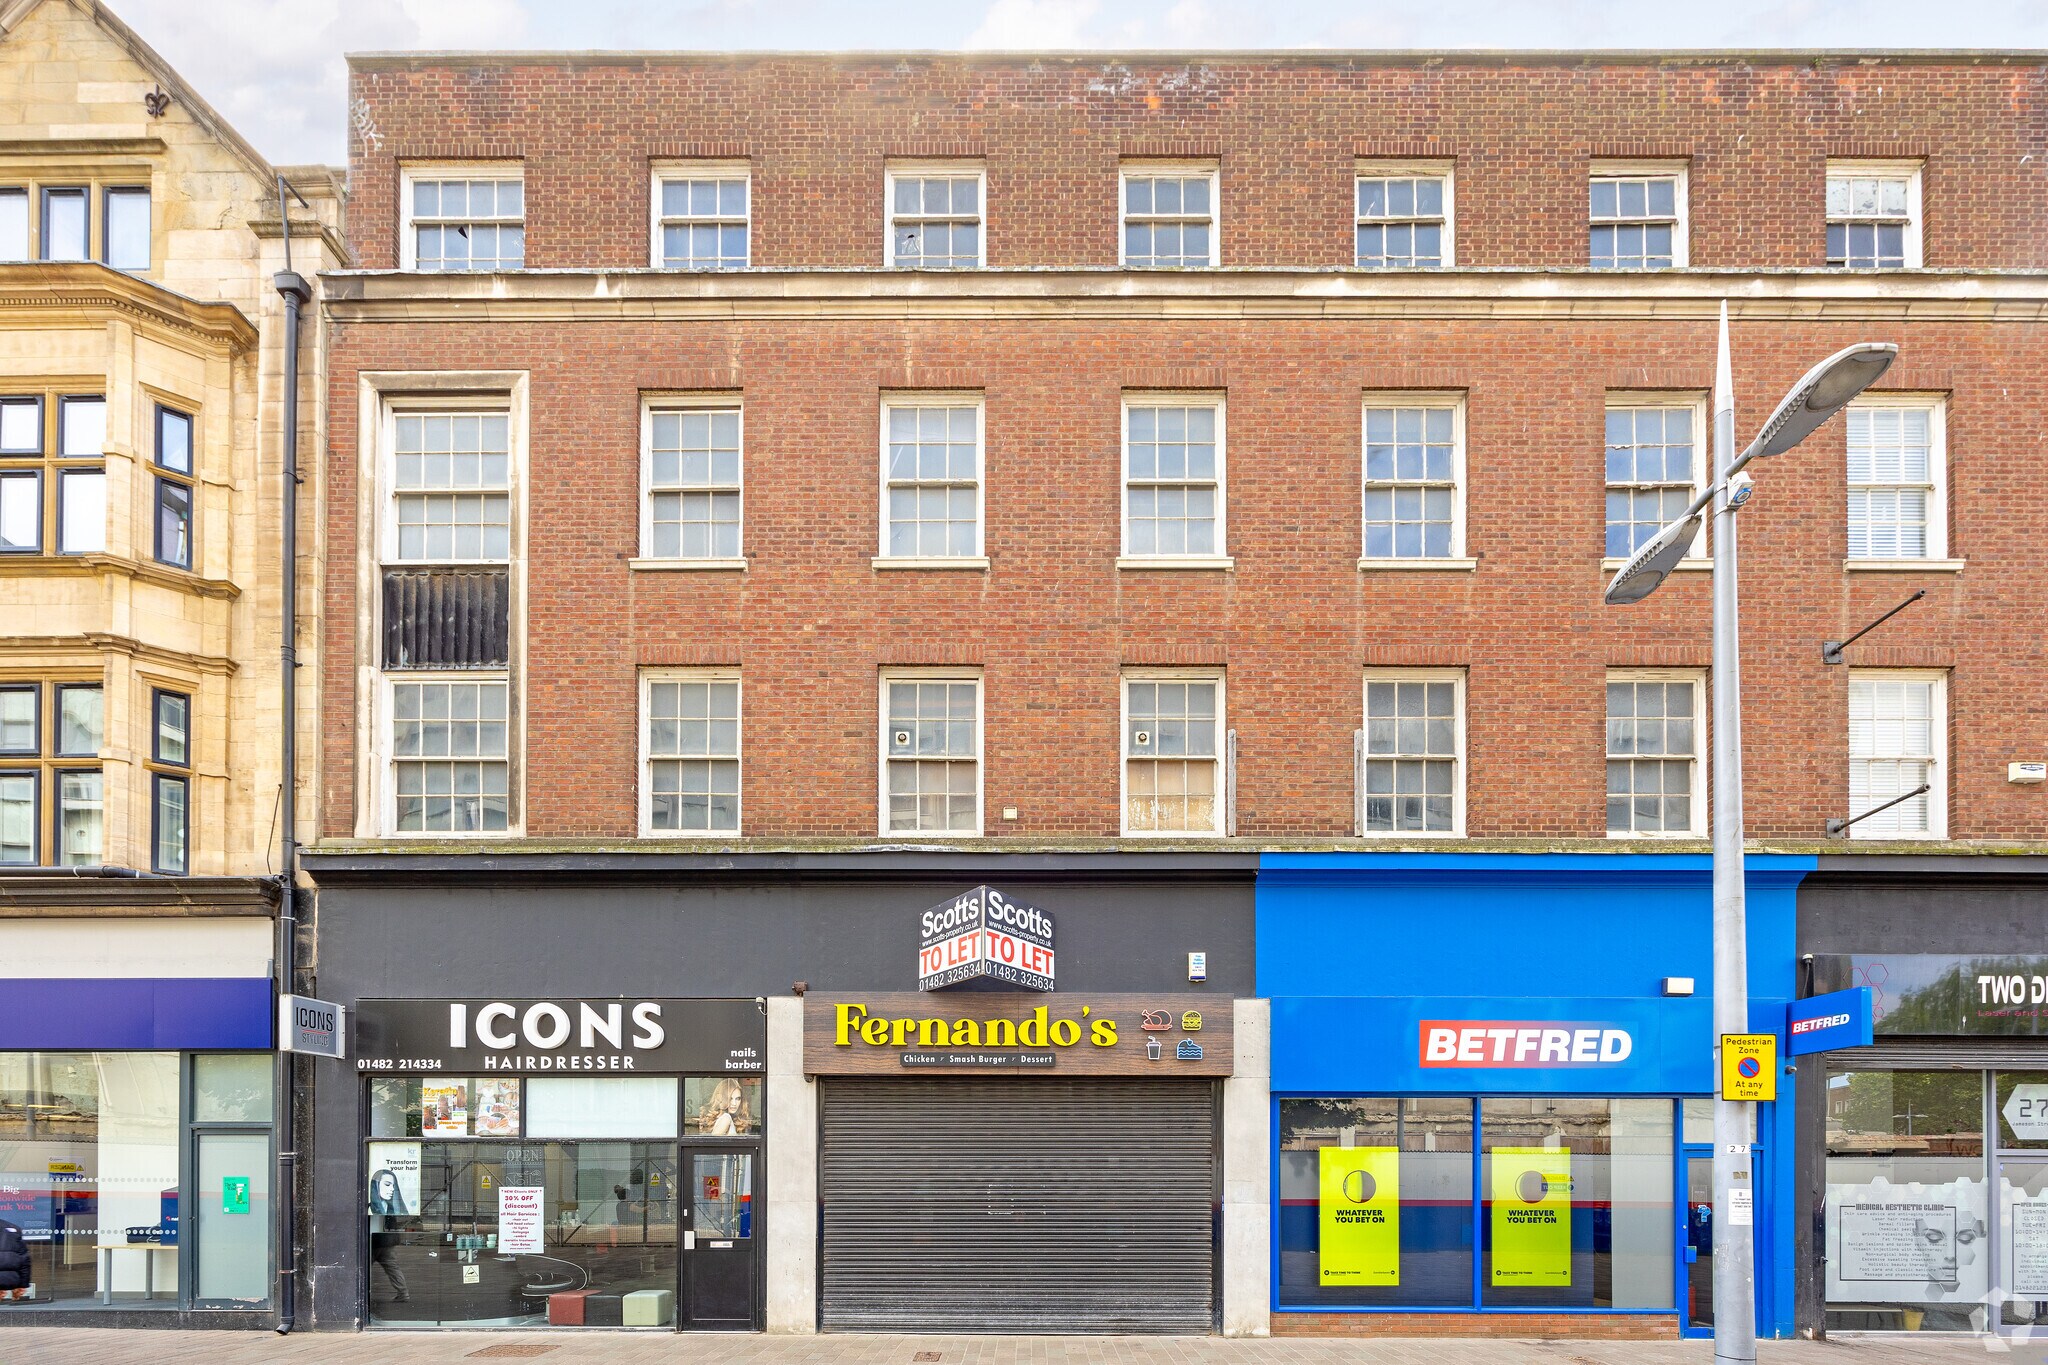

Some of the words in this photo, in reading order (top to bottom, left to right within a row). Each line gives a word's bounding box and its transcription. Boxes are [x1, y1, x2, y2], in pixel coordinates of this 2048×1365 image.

[922, 896, 979, 938] Scotts
[988, 891, 1052, 938] Scotts
[922, 920, 979, 947] www.scotts-property.co.uk
[988, 920, 1052, 947] www.scotts-property.co.uk
[921, 946, 942, 974] TO
[948, 932, 980, 966] LET
[987, 931, 1014, 963] TO
[1022, 943, 1053, 975] LET
[919, 973, 944, 991] 01482
[948, 963, 980, 983] 325634
[985, 962, 1017, 981] 01482
[1021, 972, 1054, 991] 325634
[1977, 975, 2025, 1004] TWO
[296, 1006, 333, 1032] ICONS
[450, 1002, 665, 1050] ICONS
[834, 1003, 1119, 1047] Fernando's
[1792, 1013, 1850, 1033] BETFRED
[730, 1048, 756, 1057] nails
[1425, 1028, 1633, 1062] BETFRED
[1726, 1038, 1772, 1046] Pedestrian
[357, 1059, 393, 1069] 01482
[399, 1059, 442, 1069] 214334
[484, 1056, 635, 1069] HAIRDRESSER
[725, 1059, 762, 1069] barber
[904, 1055, 935, 1063] Chicken
[949, 1055, 976, 1063] Smash
[978, 1055, 1007, 1065] Burger
[1021, 1055, 1052, 1063] Dessert
[506, 1149, 539, 1161] OPEN
[3, 1185, 20, 1194] Big
